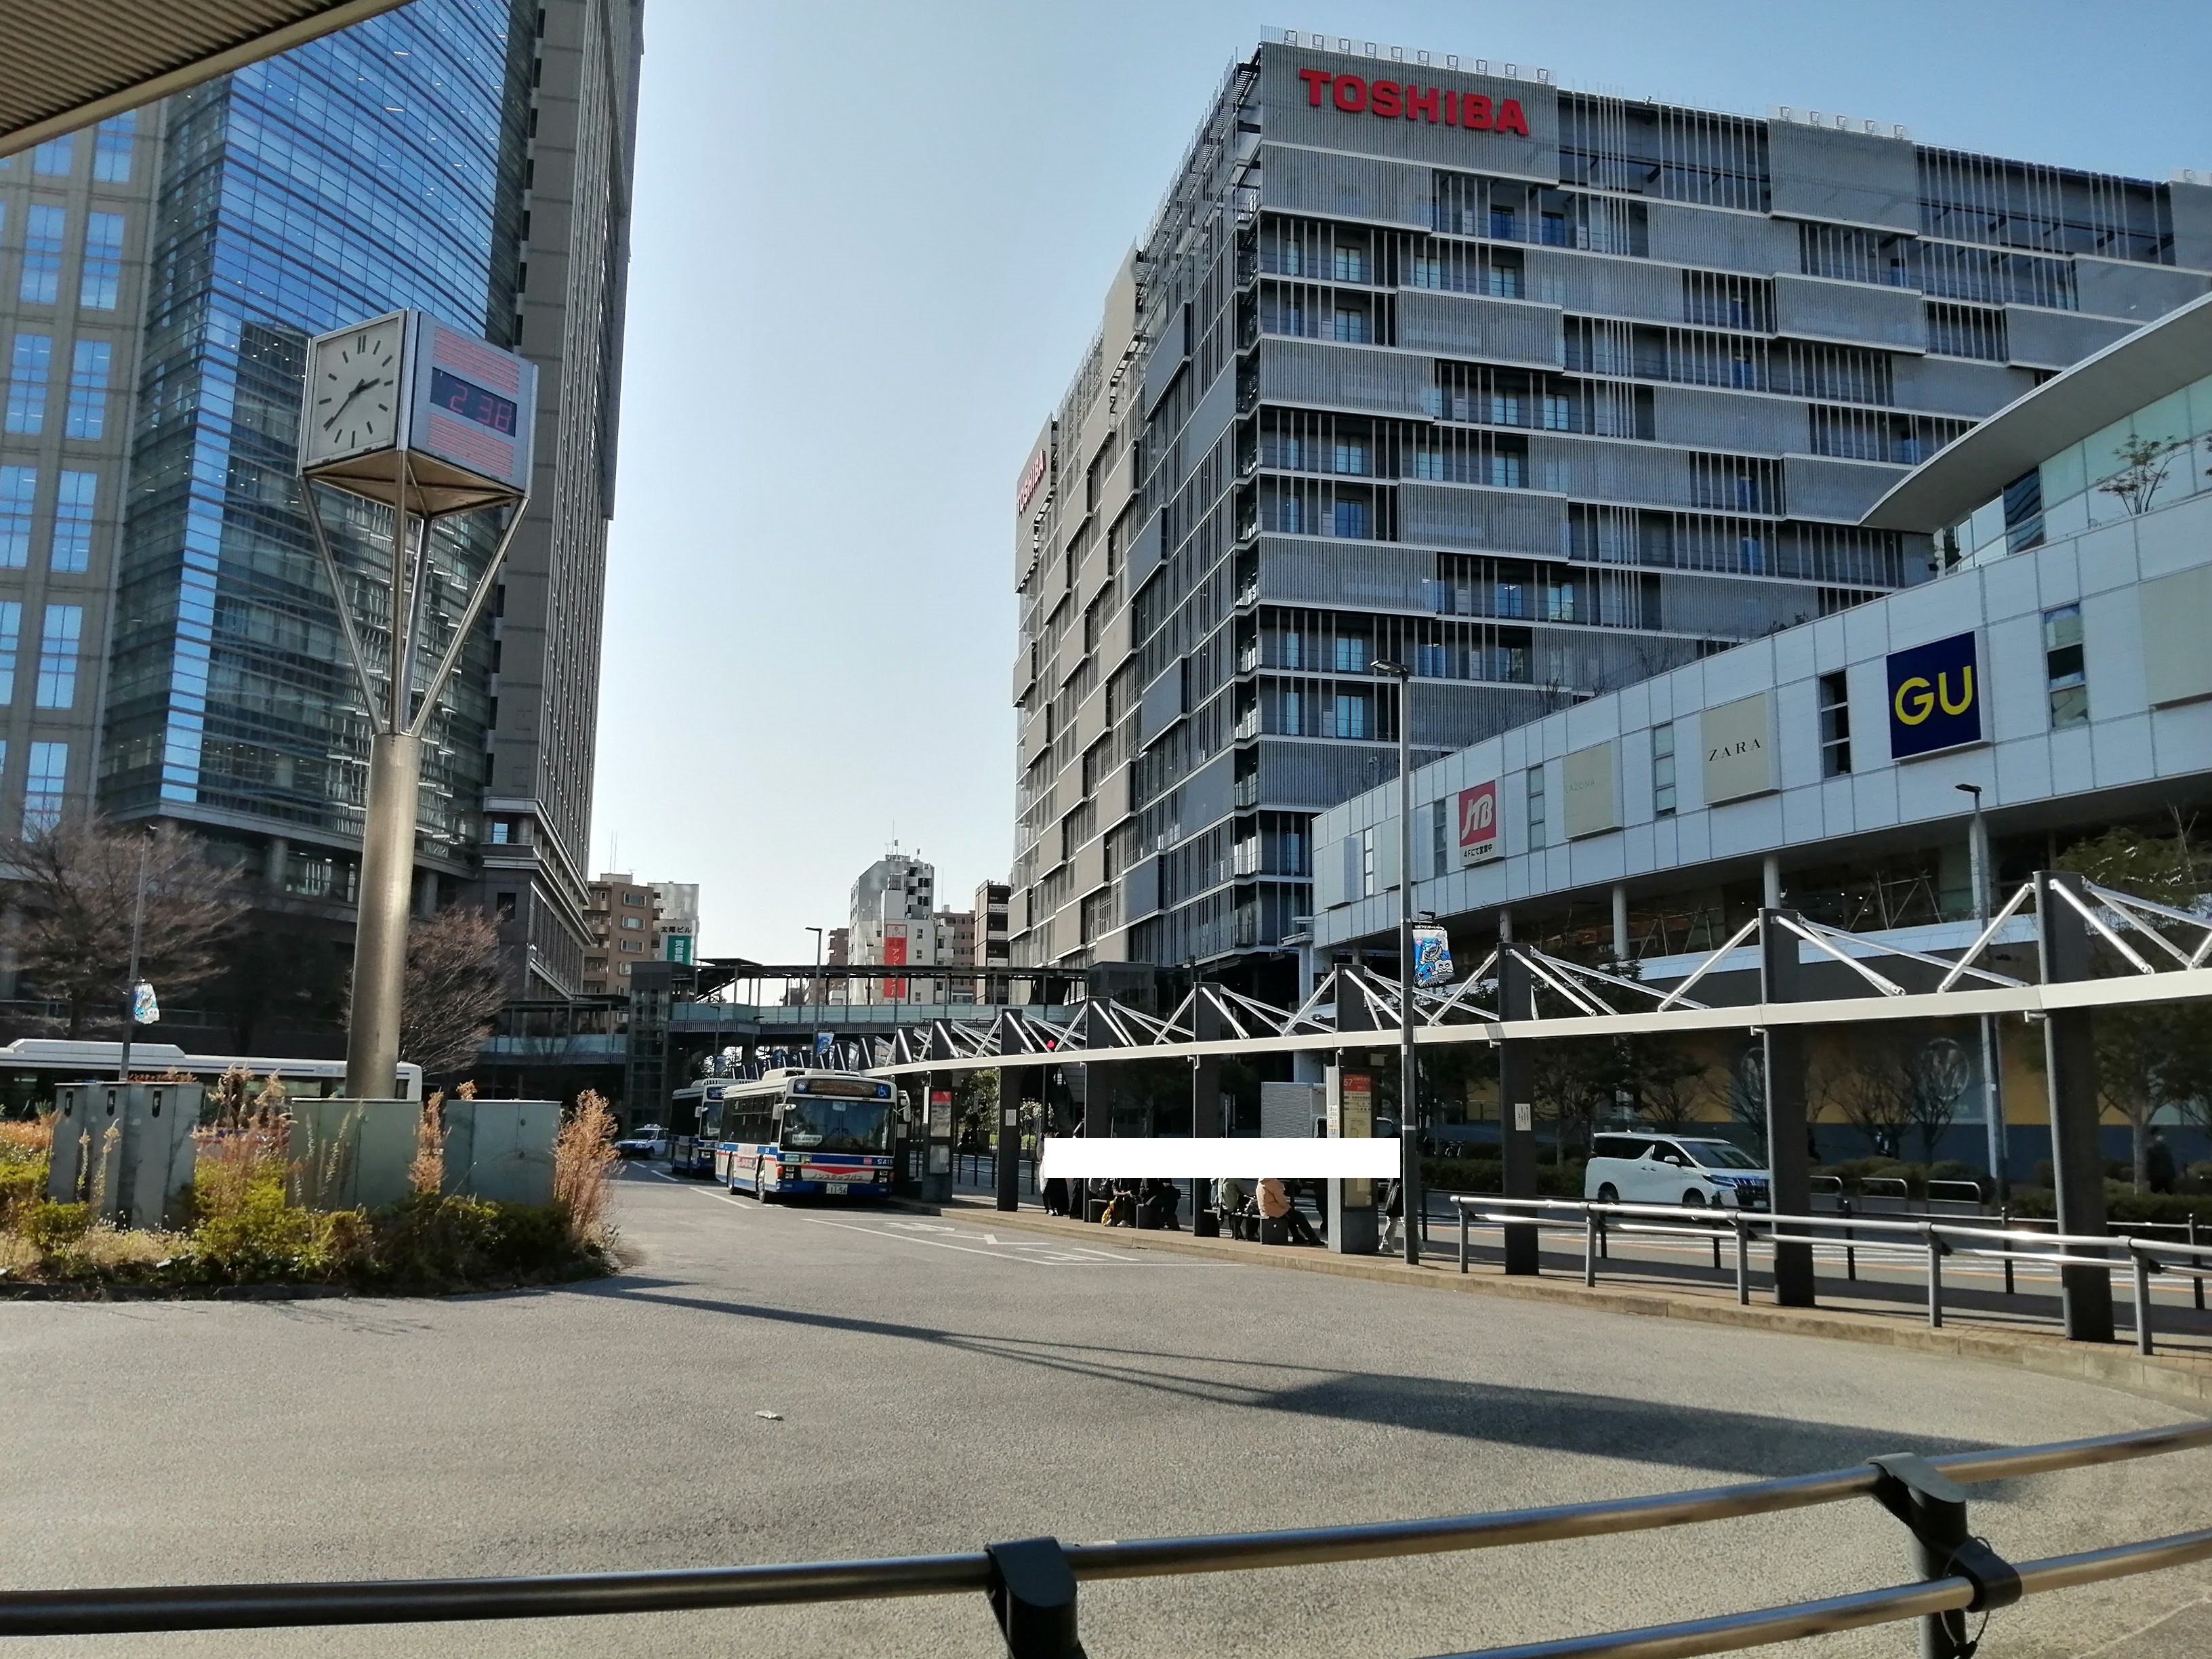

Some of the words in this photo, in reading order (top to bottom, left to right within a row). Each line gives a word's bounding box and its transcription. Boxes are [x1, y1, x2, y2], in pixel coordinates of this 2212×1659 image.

[1299, 68, 1530, 136] TOSHIBA
[1017, 449, 1046, 518] TOSHIBA
[1895, 665, 1973, 725] GU
[1708, 738, 1762, 761] ZARA
[1461, 794, 1493, 840] JTB
